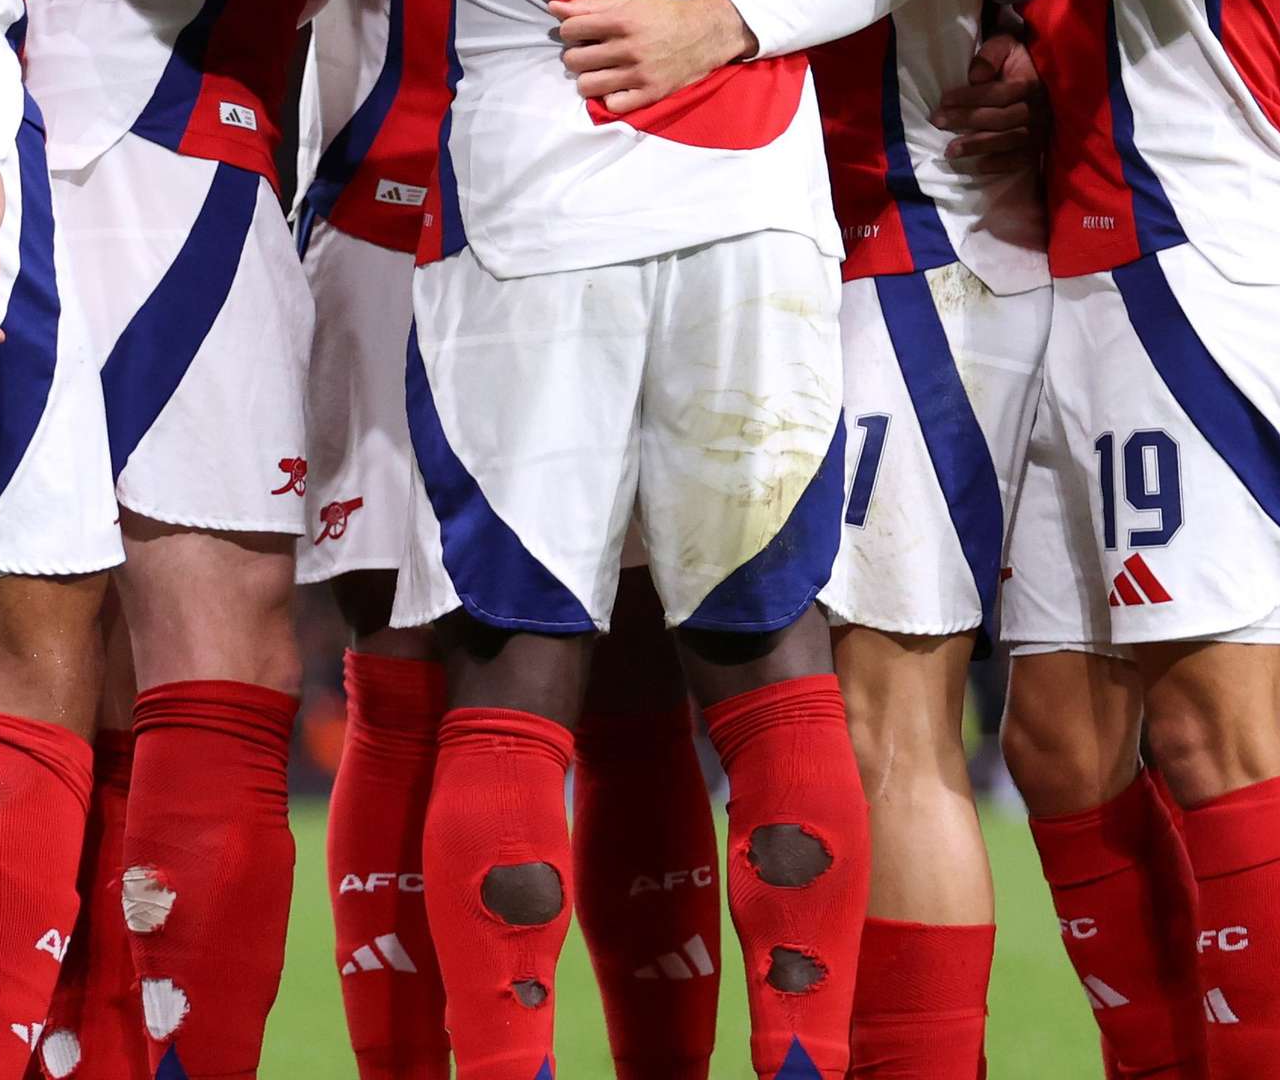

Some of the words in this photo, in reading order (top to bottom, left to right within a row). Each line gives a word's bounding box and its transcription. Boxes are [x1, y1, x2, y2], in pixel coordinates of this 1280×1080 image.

[1094, 428, 1185, 551] 19
[339, 872, 425, 895] AFC
[629, 865, 712, 896] AFC
[1196, 925, 1249, 954] FC
